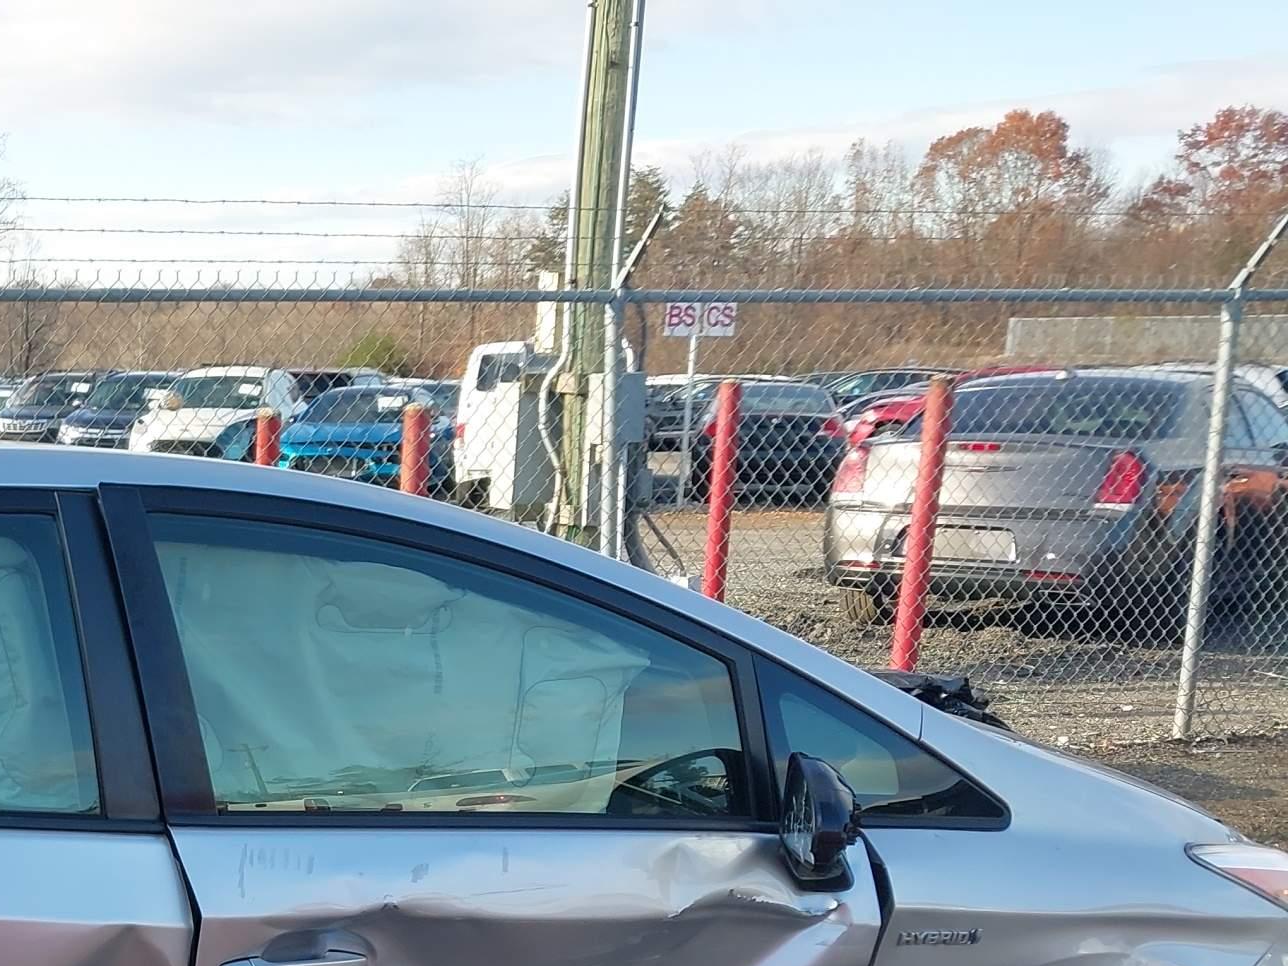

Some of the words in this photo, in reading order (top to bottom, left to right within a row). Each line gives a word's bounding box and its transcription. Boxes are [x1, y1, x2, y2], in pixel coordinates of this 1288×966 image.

[667, 304, 697, 328] BS
[706, 304, 735, 328] CS
[896, 931, 970, 946] HYBRID
